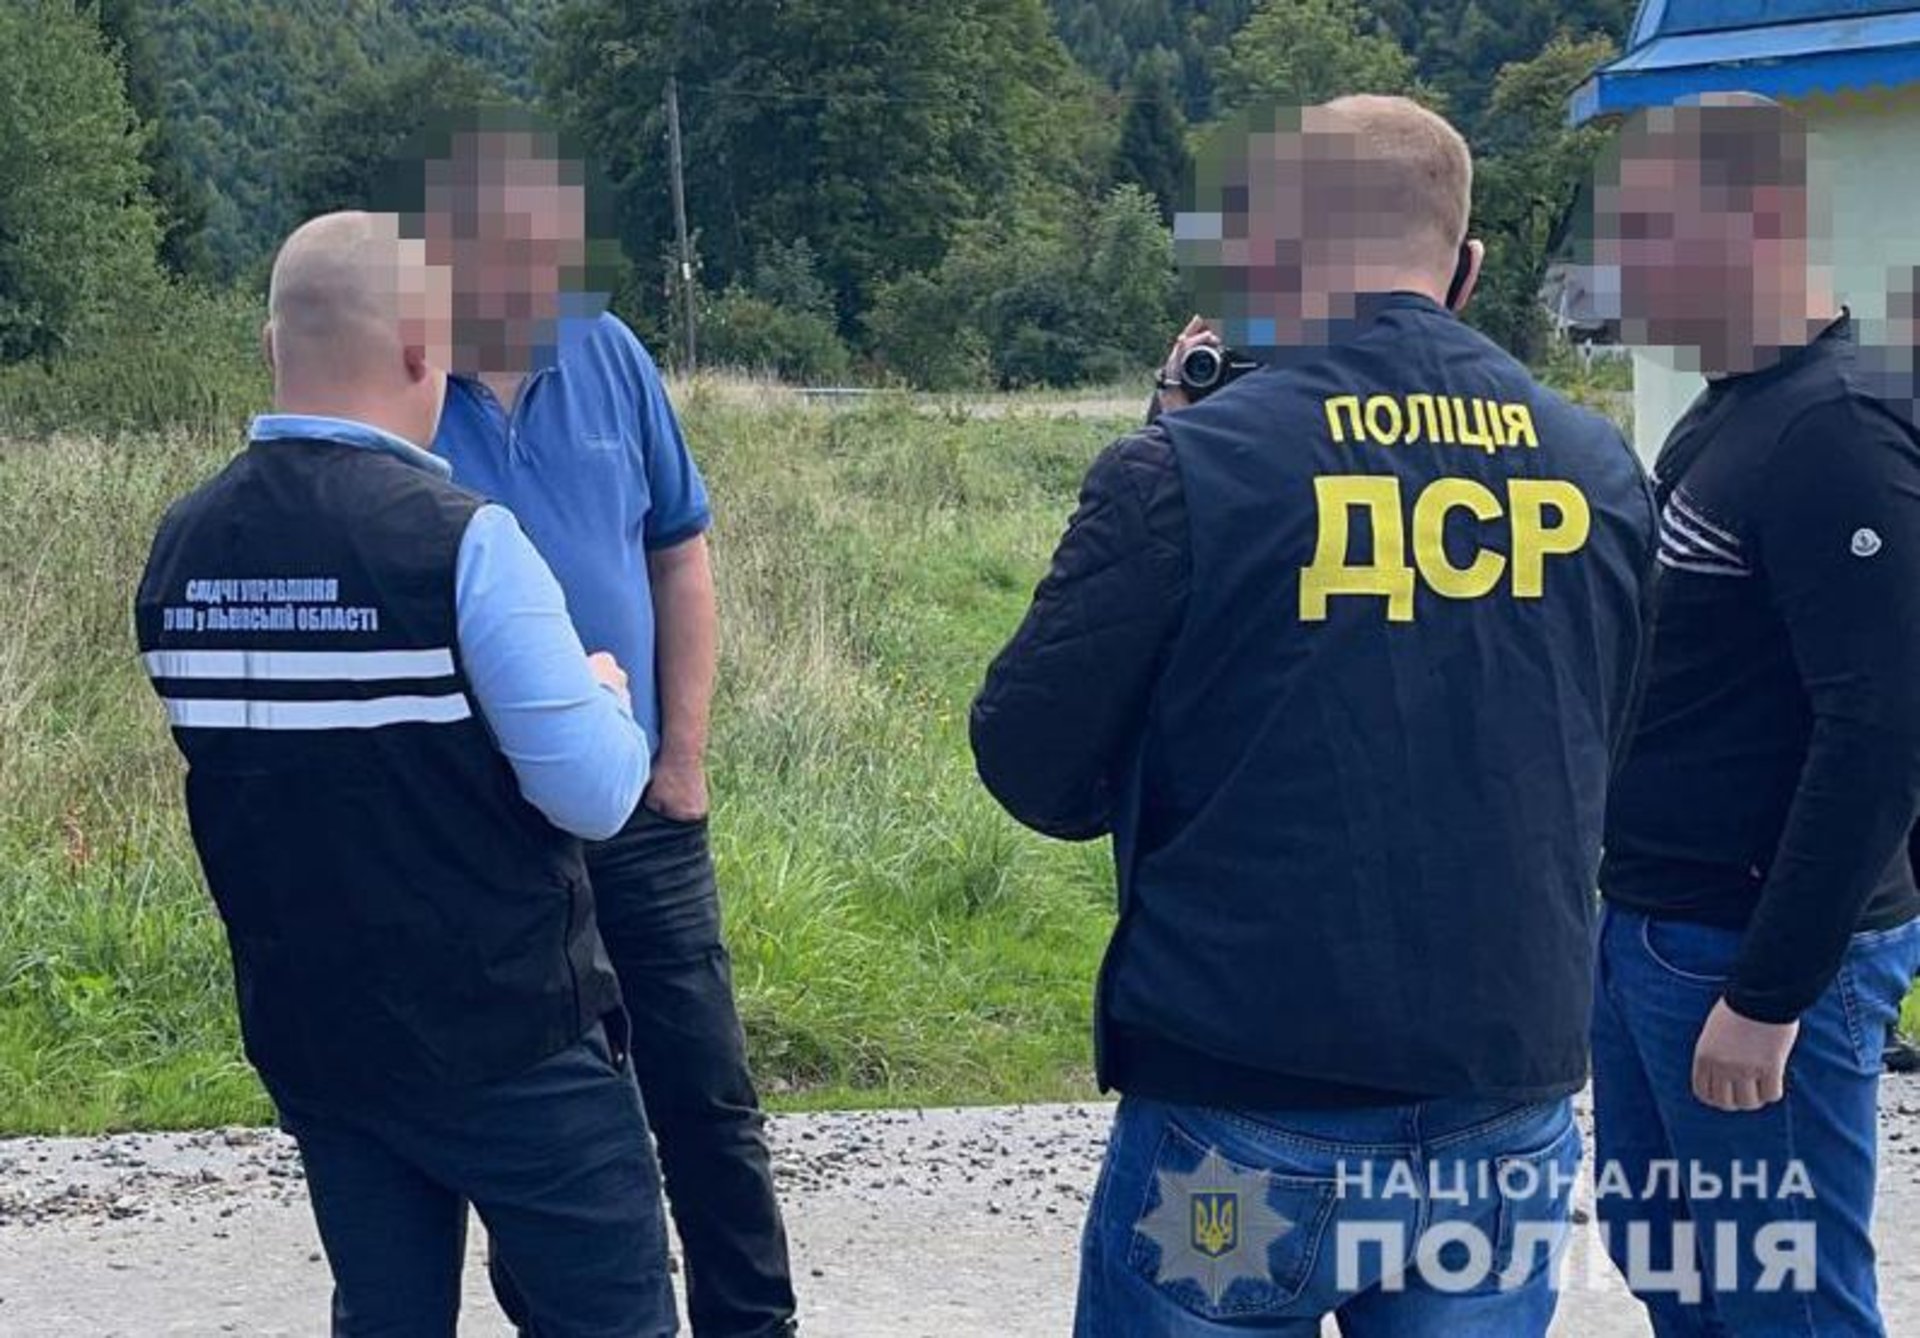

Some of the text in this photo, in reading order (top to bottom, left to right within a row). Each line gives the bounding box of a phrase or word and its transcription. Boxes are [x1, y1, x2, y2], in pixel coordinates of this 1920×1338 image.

[1325, 394, 1538, 453] ПОЛІЦІЯ
[1300, 475, 1590, 620] ДСР
[297, 608, 378, 631] ОБЛАСТІ
